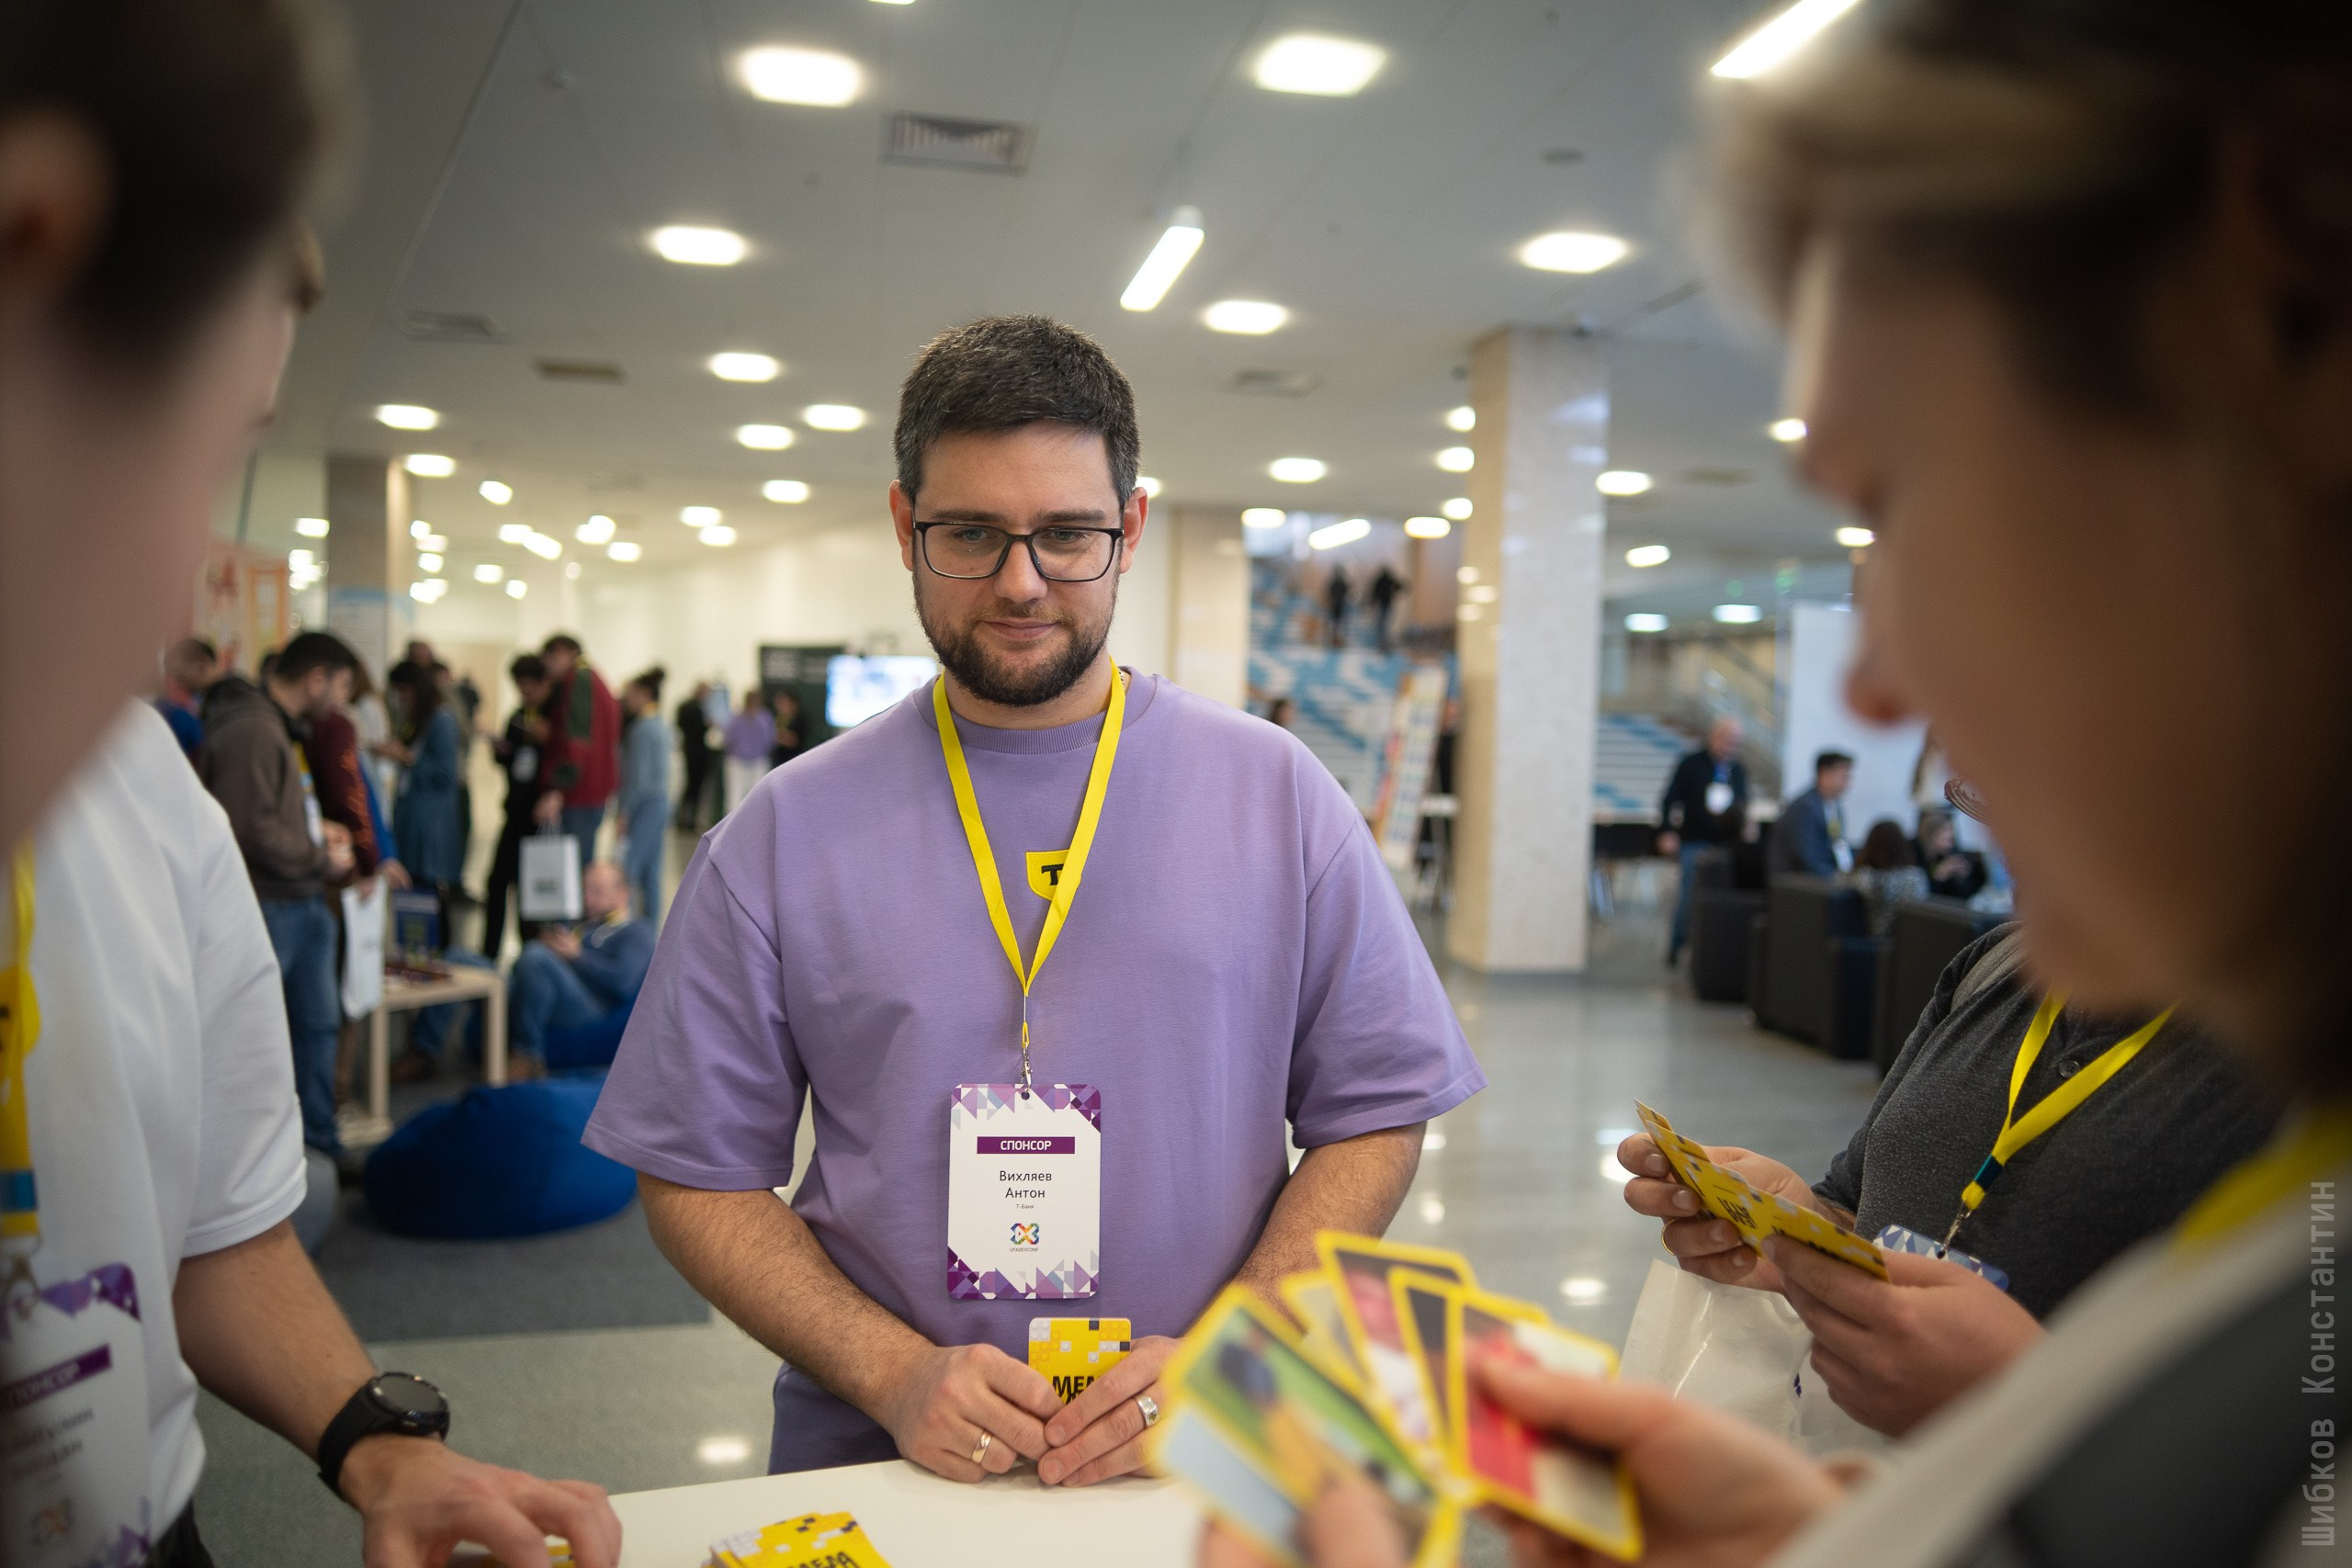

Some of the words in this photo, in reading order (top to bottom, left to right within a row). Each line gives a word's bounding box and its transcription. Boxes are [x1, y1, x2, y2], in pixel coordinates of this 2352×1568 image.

[1000, 1140, 1052, 1151] СПОНСОР
[1000, 1170, 1052, 1181] Вихляев
[1005, 1187, 1046, 1198] Антон
